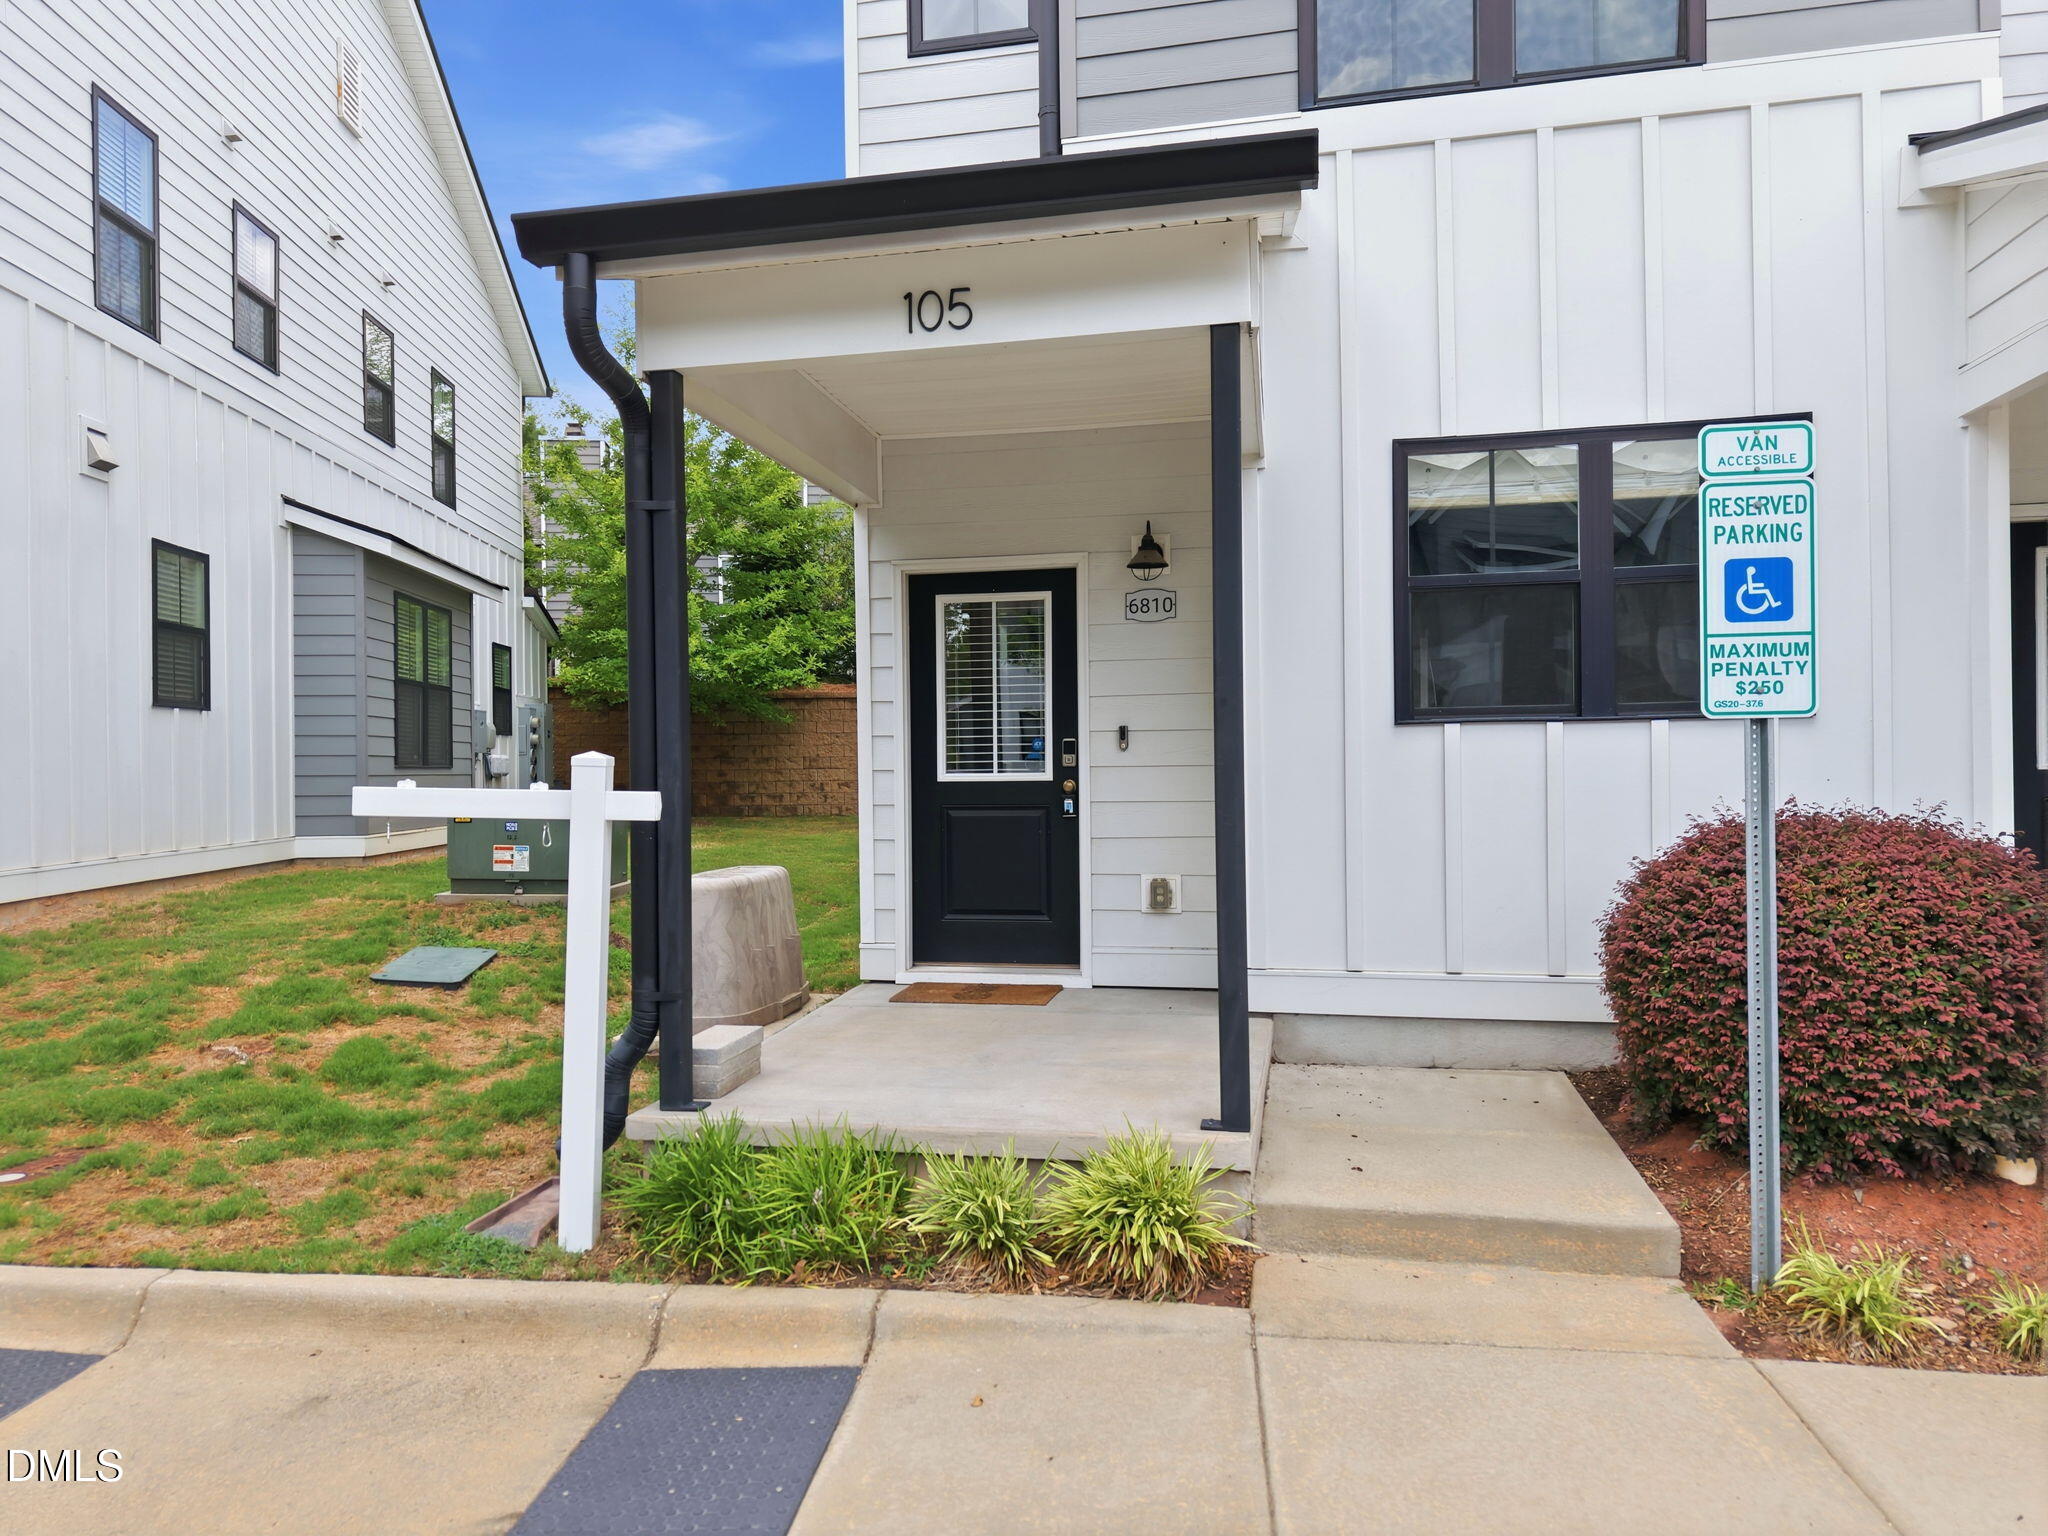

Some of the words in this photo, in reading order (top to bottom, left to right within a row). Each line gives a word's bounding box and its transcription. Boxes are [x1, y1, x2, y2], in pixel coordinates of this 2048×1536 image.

[903, 287, 973, 334] 105
[1736, 434, 1778, 451] VAN
[1717, 453, 1798, 467] ACCESSIBLE
[1708, 494, 1808, 517] RESERVED
[1713, 522, 1803, 545] PARKING
[1129, 596, 1173, 614] 6810
[1710, 641, 1810, 658] MAXIMUM
[1711, 660, 1809, 677] PENALTY
[1735, 680, 1784, 696] $250
